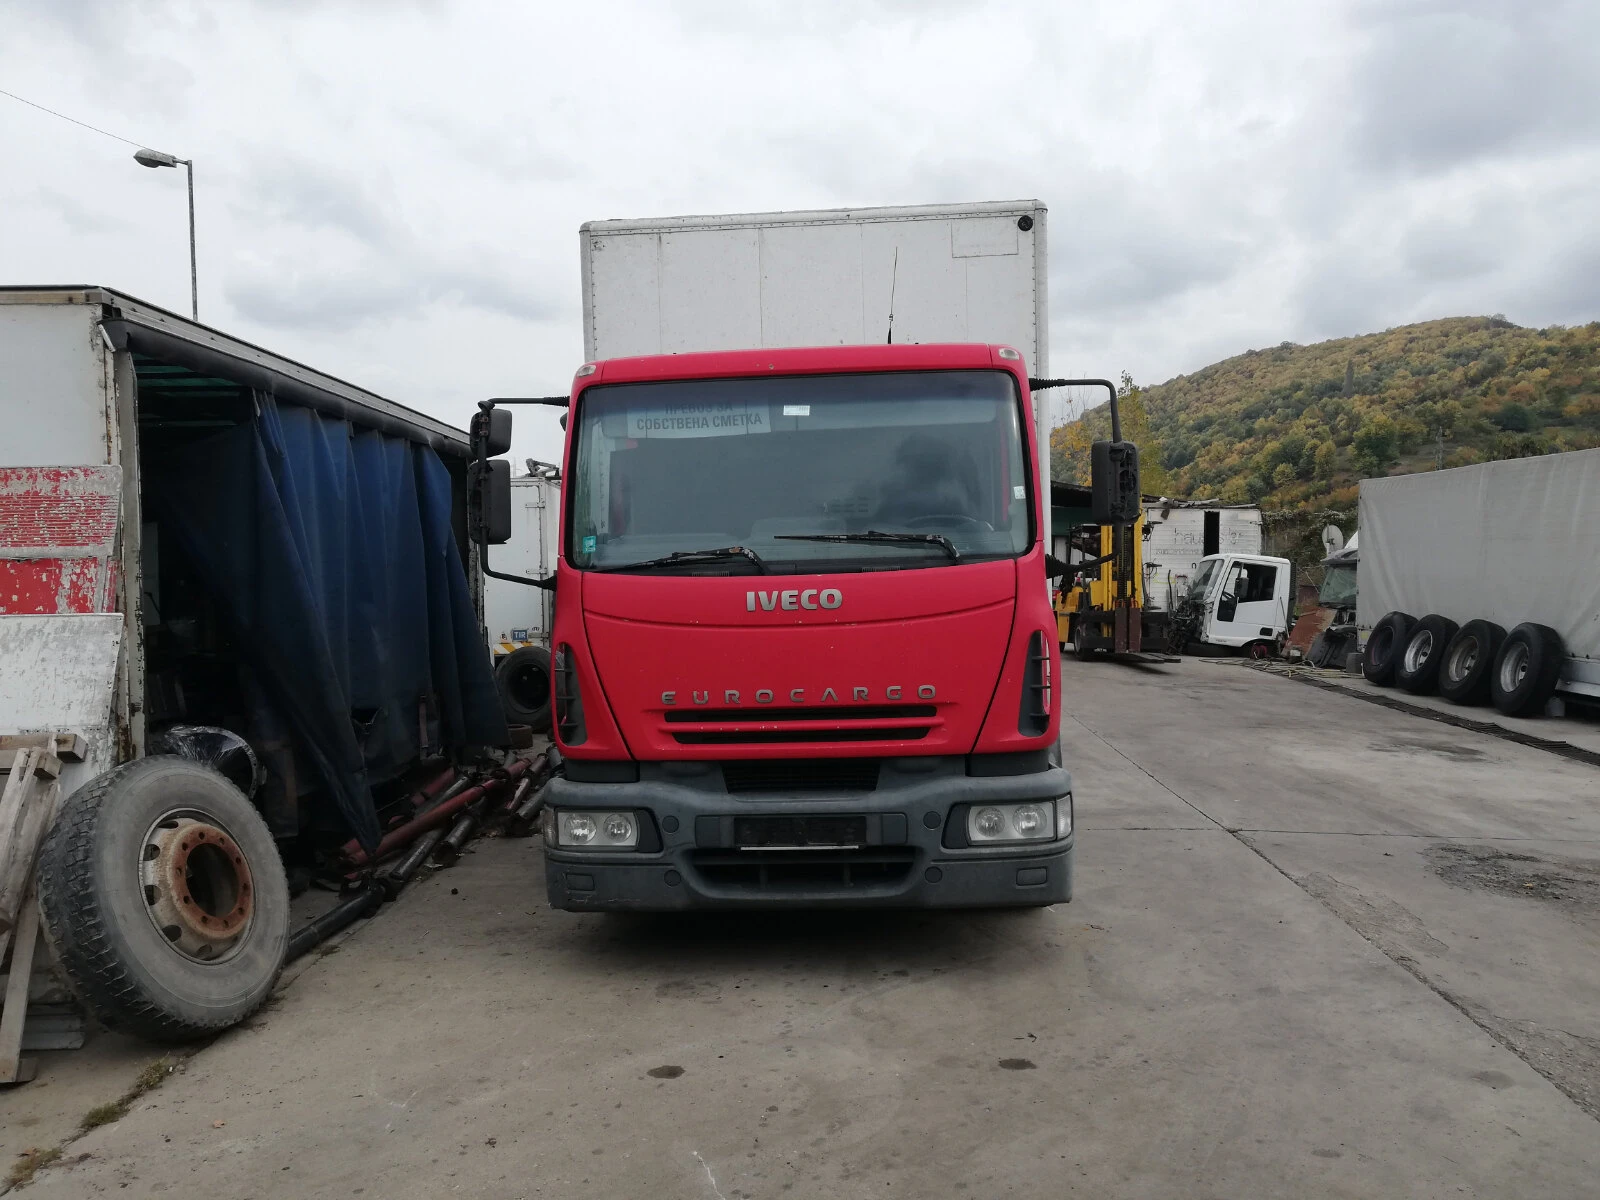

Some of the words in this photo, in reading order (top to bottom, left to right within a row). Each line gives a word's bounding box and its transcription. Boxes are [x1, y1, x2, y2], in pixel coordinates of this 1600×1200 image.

[637, 416, 709, 431] СОБСТВЕНА
[712, 413, 763, 428] СМЕТКА
[746, 588, 843, 612] IVECO
[661, 684, 937, 705] EUROCARGO
